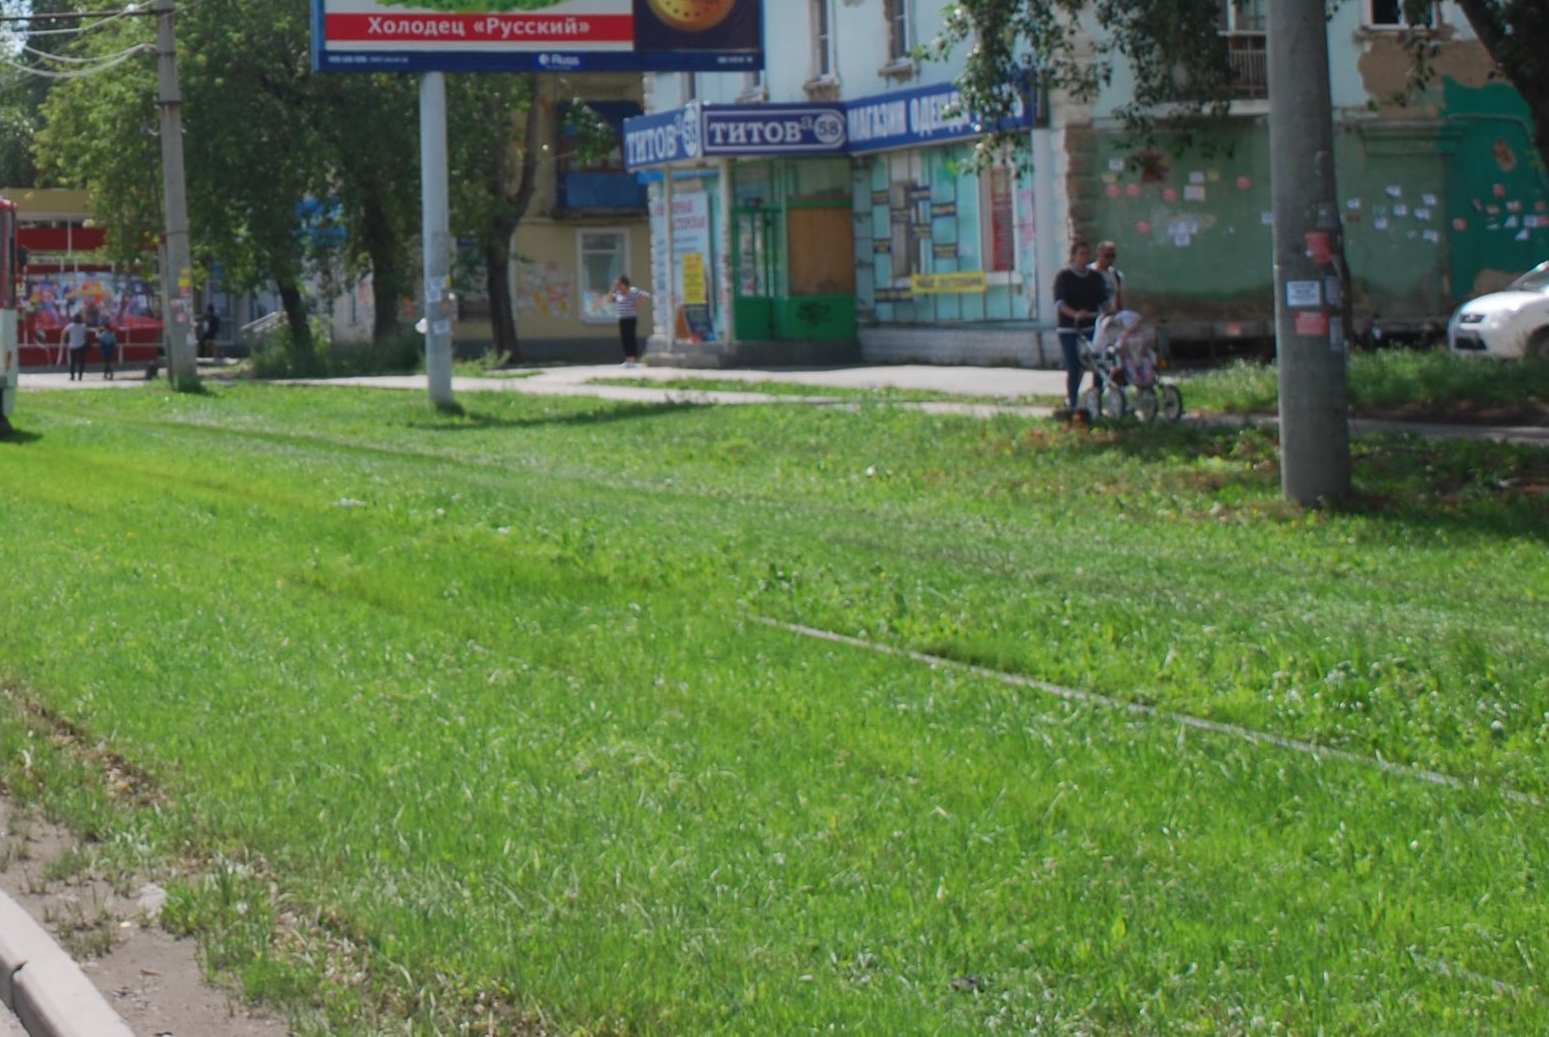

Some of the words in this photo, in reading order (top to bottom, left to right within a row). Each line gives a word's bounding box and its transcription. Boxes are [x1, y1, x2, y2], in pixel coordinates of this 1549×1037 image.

[367, 16, 466, 37] Холодец
[473, 17, 590, 39] «Русский»
[847, 99, 908, 143] МАГАЗИН
